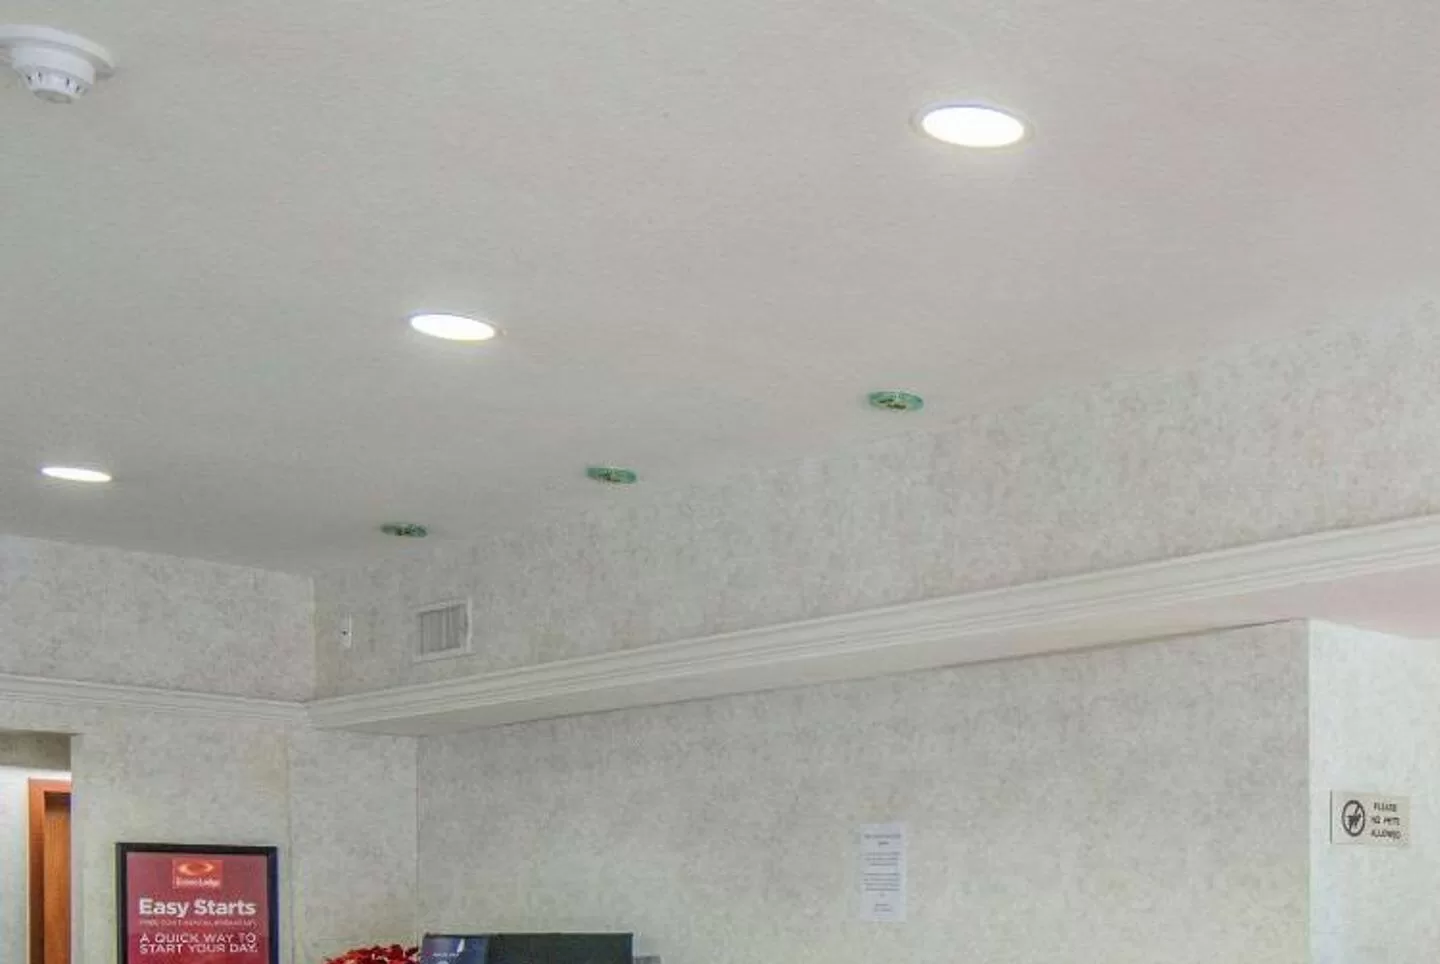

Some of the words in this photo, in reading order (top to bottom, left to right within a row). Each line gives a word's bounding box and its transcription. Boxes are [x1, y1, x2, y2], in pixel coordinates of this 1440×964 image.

[139, 898, 189, 918] Easy
[194, 898, 257, 916] Starts
[140, 933, 150, 943] A
[154, 932, 200, 944] QUICK
[203, 933, 235, 943] WAY
[239, 932, 257, 943] TO
[140, 943, 184, 954] START
[188, 943, 226, 953] YOUR
[229, 943, 259, 953] DAY.
